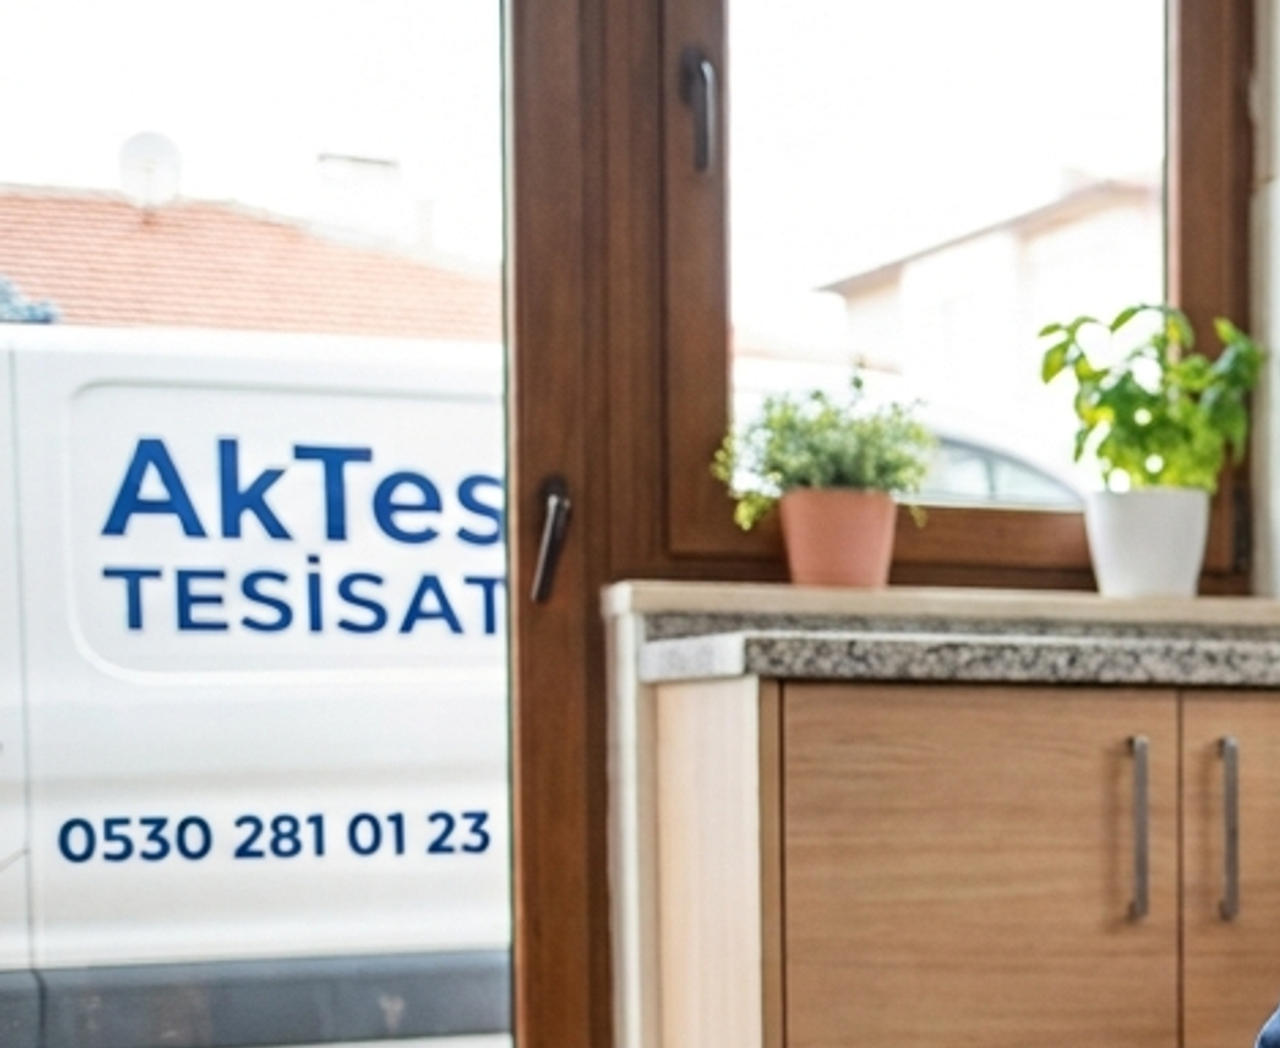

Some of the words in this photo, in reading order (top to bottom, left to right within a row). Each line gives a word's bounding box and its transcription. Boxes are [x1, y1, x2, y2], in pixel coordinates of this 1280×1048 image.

[101, 438, 506, 547] AkTes
[57, 815, 213, 864] 0530
[233, 813, 325, 859] 281
[347, 812, 405, 856] 01
[427, 811, 491, 855] 23
